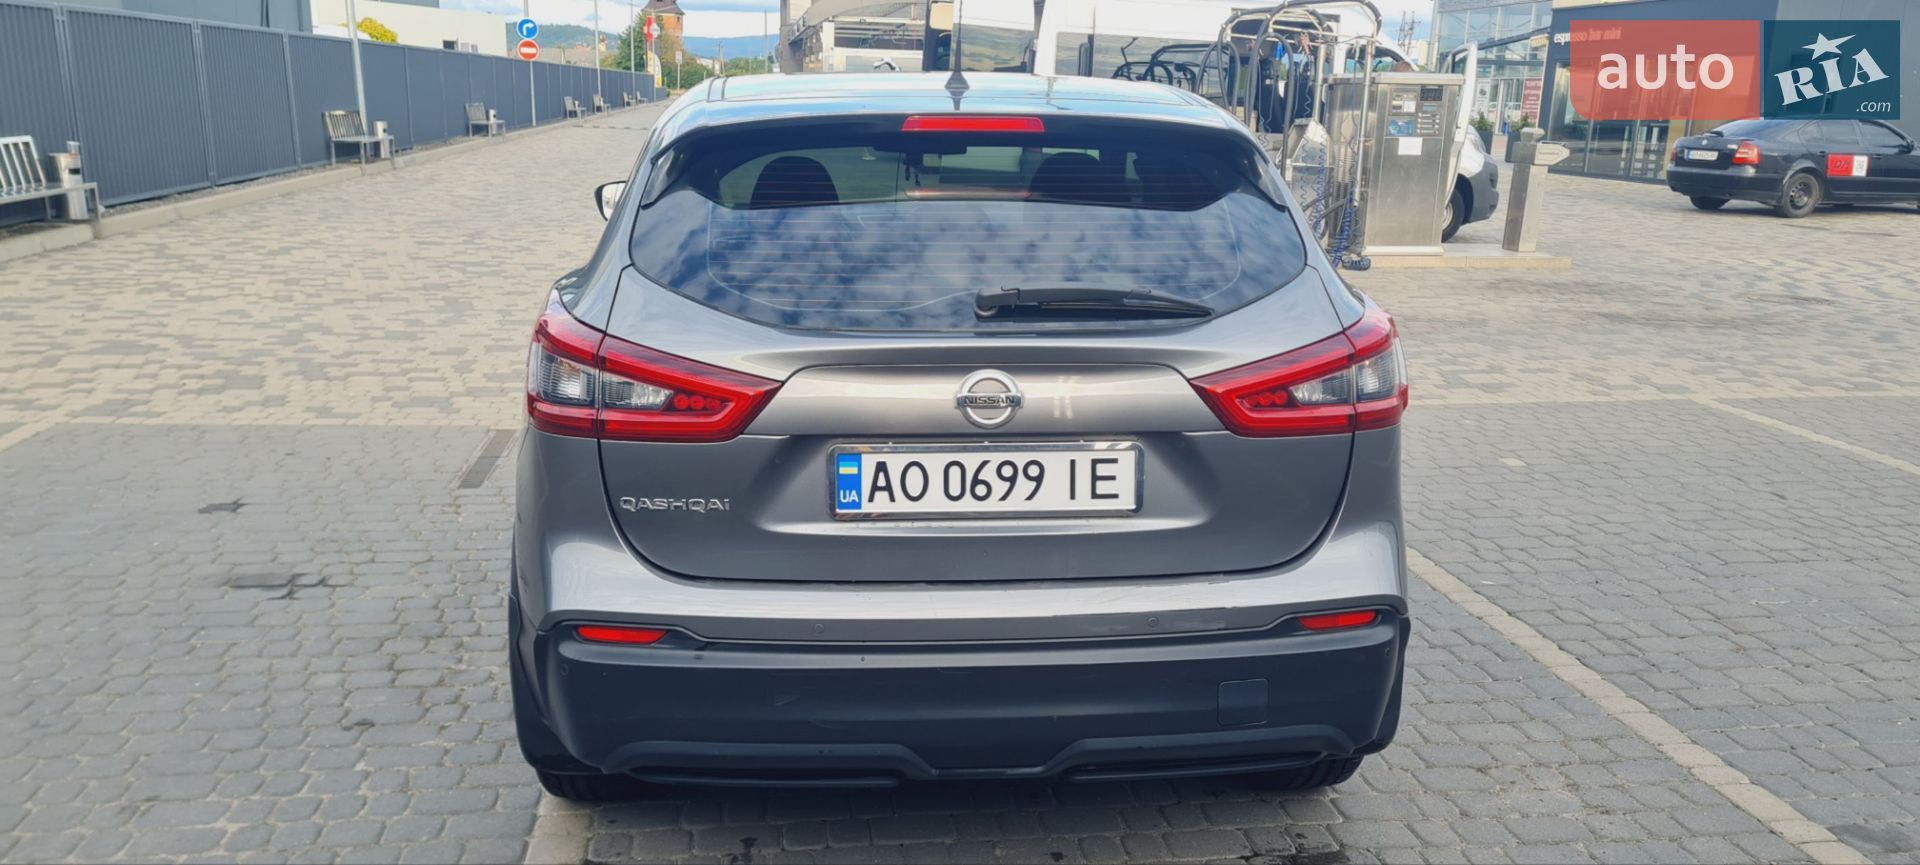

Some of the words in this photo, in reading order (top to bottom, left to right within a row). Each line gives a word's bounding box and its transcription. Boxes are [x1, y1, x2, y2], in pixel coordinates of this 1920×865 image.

[964, 396, 1015, 405] NISSAN
[867, 460, 930, 503] AO
[942, 459, 1046, 502] 0699
[1069, 457, 1120, 501] IE
[839, 489, 859, 503] UA
